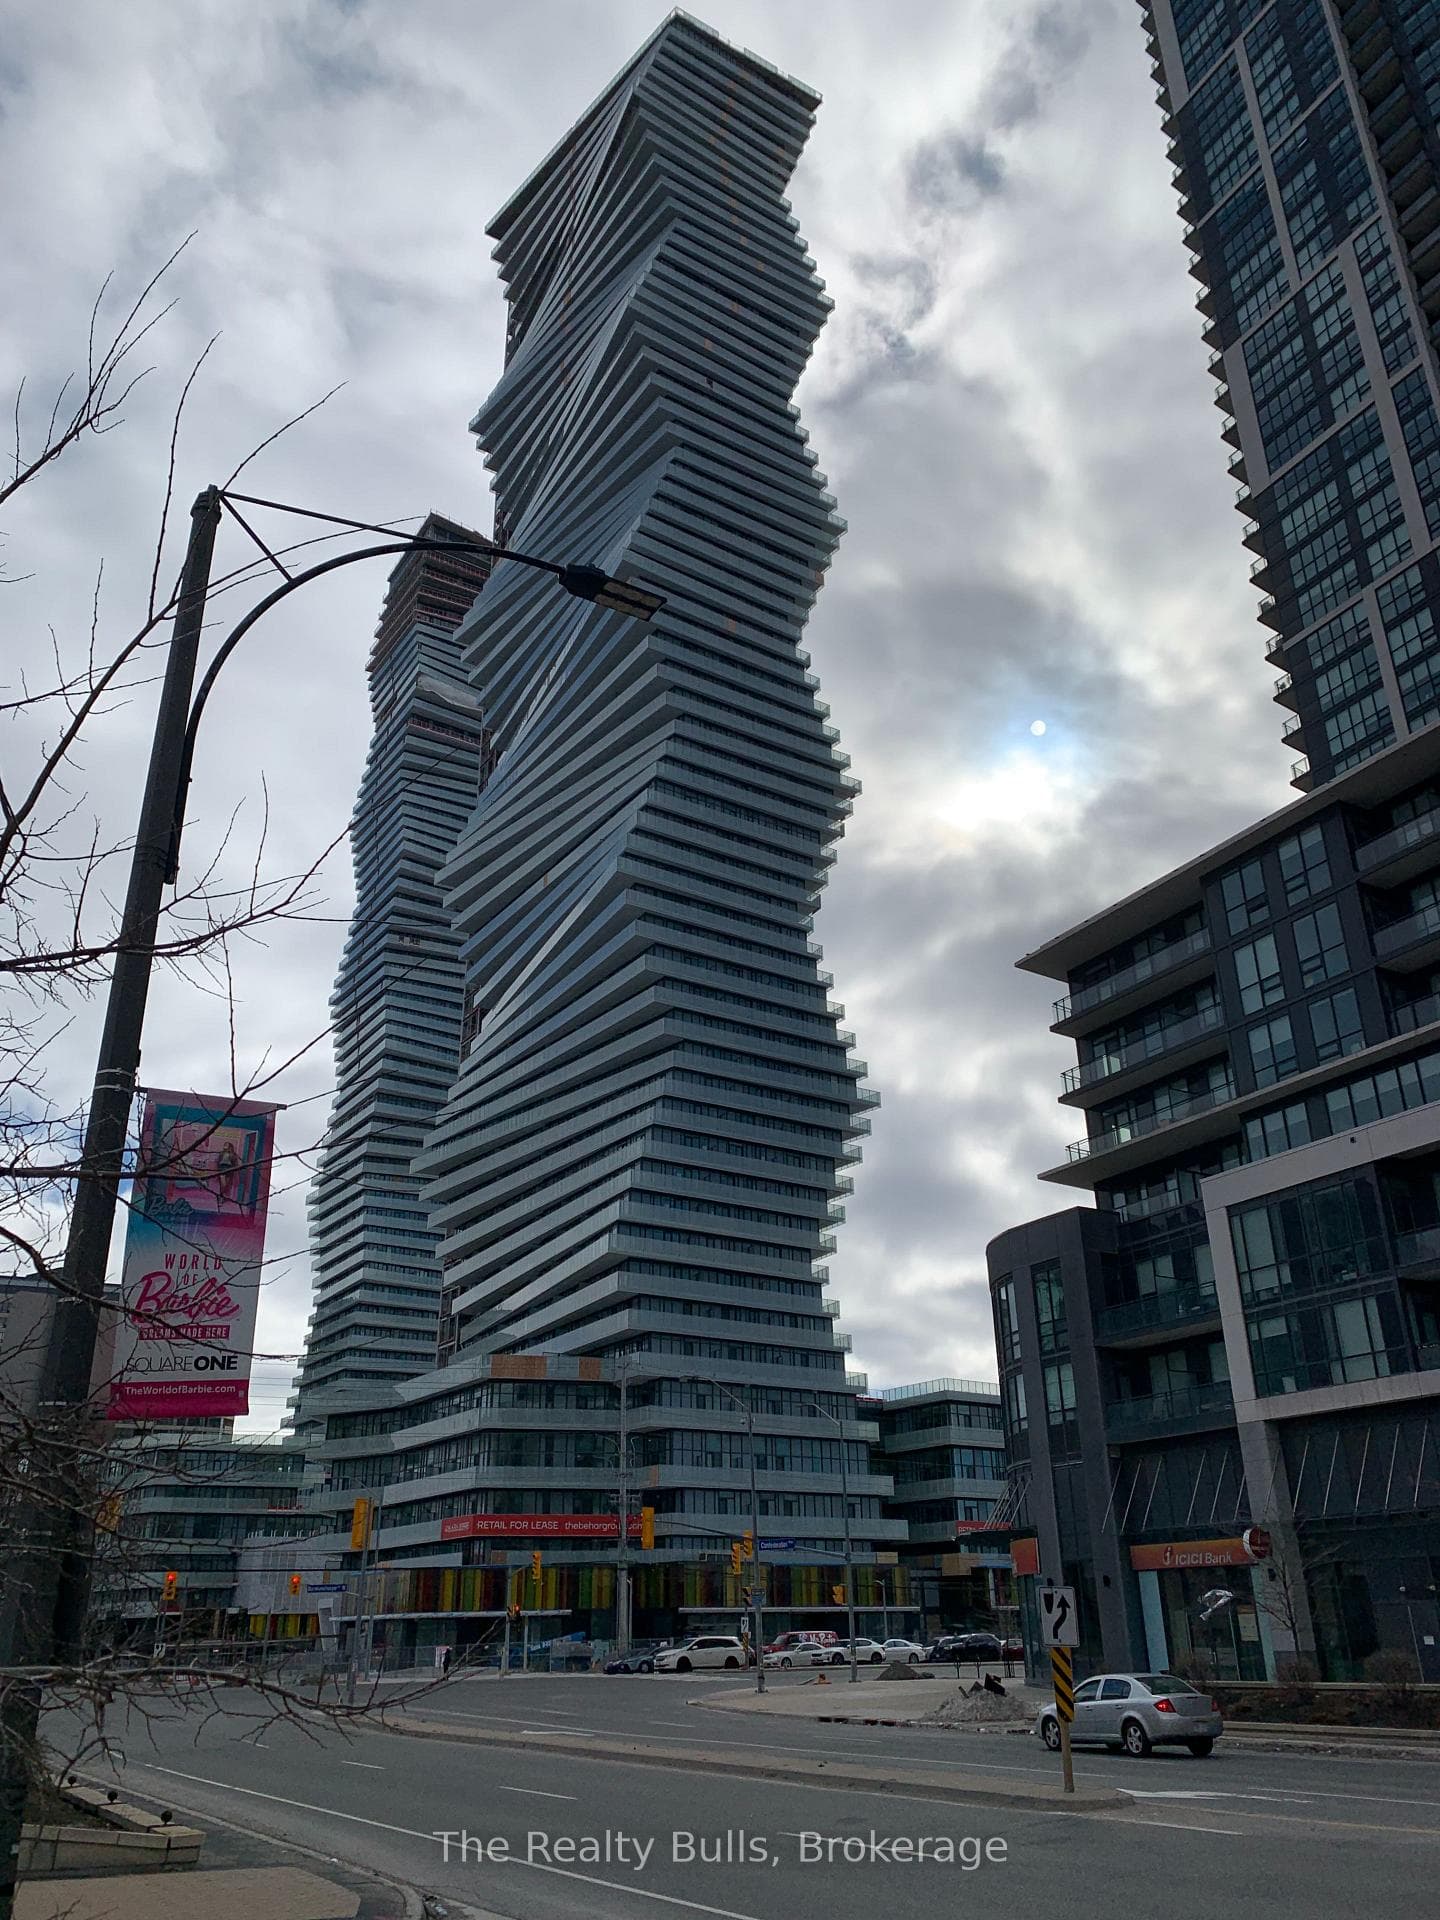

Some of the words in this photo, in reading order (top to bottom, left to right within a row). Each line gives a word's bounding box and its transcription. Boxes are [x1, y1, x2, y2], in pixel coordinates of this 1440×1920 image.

[165, 1253, 222, 1270] WORLD
[183, 1273, 199, 1286] OF
[132, 1271, 239, 1323] Barbie
[180, 1327, 203, 1338] MADE
[206, 1327, 227, 1338] HERE
[125, 1385, 236, 1396] TheWorldofBarbie.com
[477, 1520, 508, 1530] RETAIL
[510, 1520, 529, 1530] FOR
[531, 1520, 559, 1530] LEASE
[1175, 1554, 1203, 1566] ICICI
[1205, 1552, 1232, 1564] Bank
